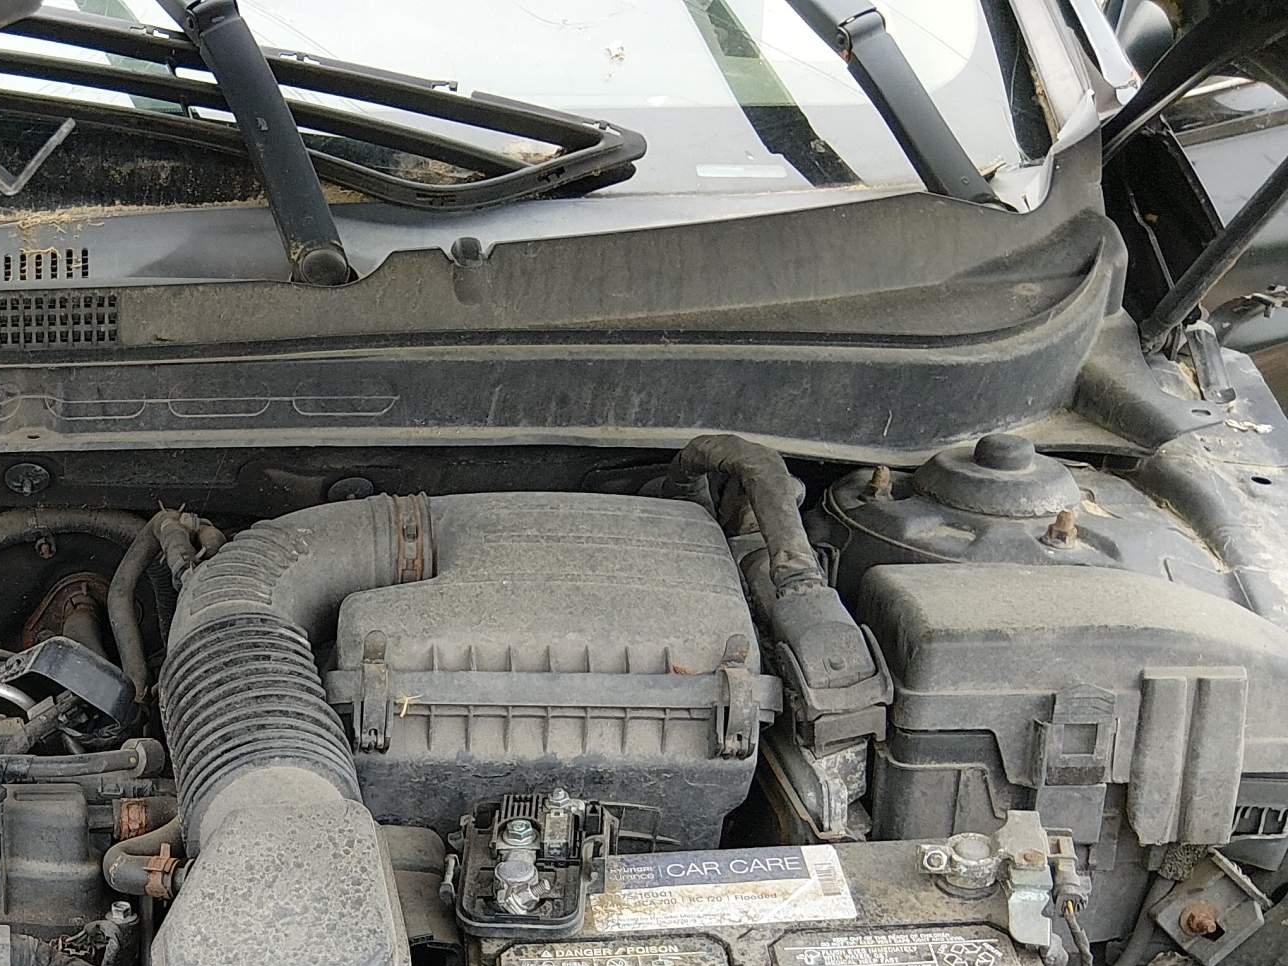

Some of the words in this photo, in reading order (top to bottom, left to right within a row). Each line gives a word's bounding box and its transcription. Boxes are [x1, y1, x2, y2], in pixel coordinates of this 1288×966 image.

[666, 861, 721, 877] CAR
[729, 857, 802, 874] CARE
[555, 948, 613, 957] DANGER
[626, 945, 679, 954] POISON
